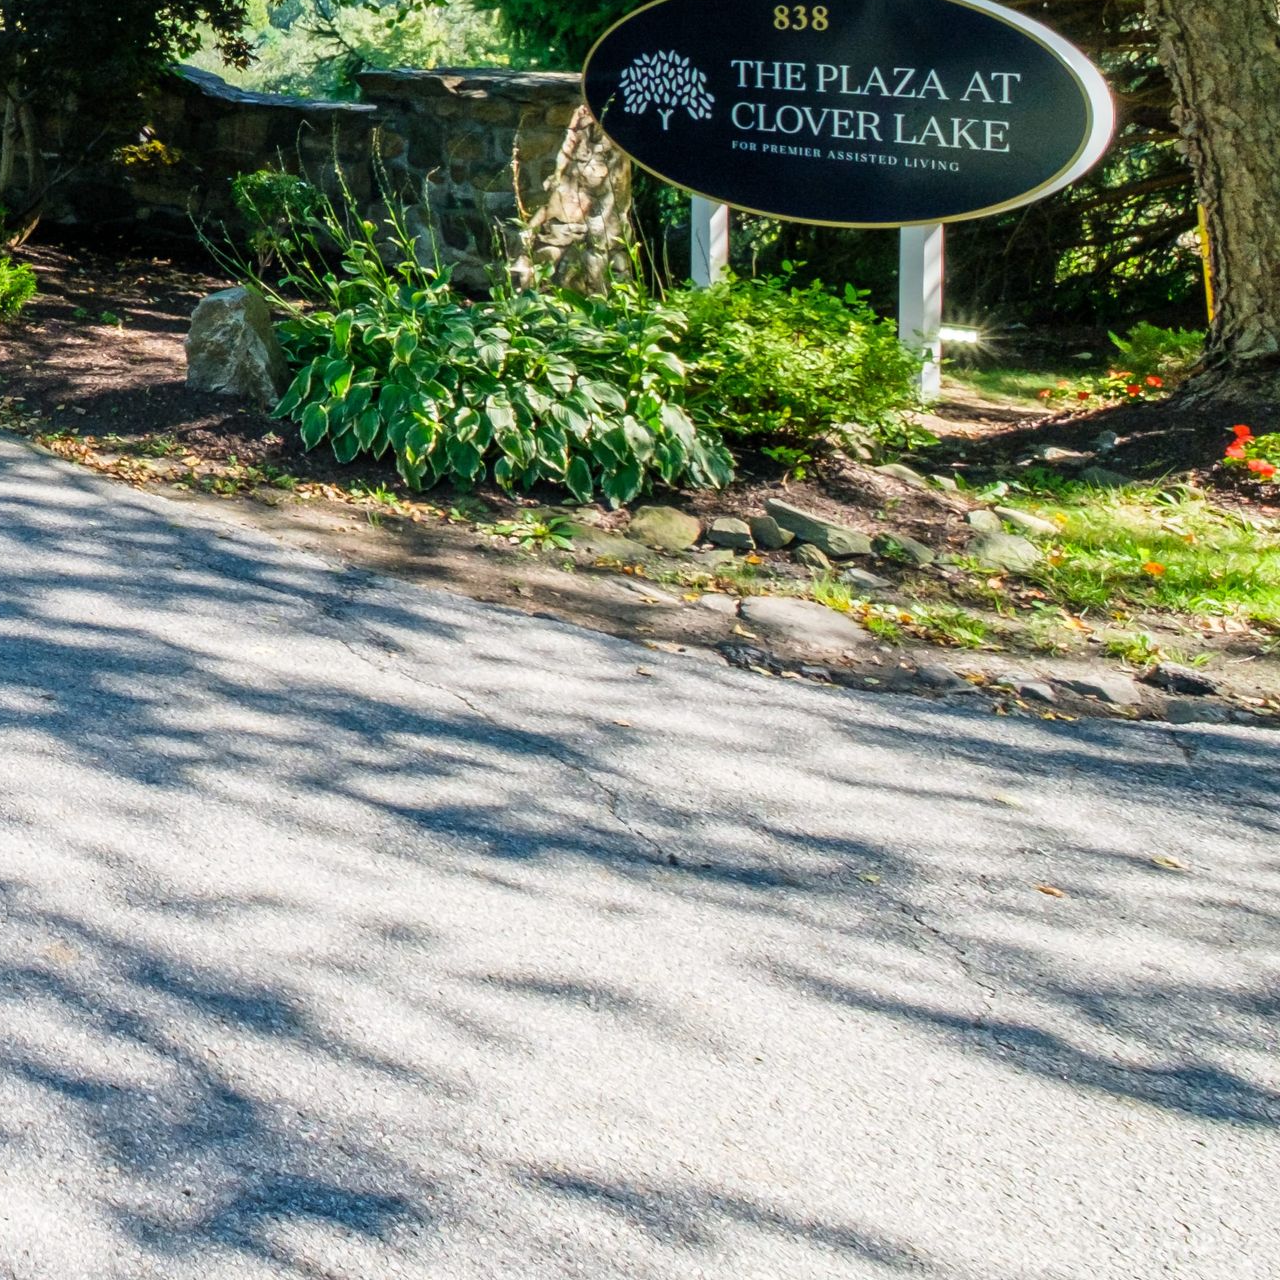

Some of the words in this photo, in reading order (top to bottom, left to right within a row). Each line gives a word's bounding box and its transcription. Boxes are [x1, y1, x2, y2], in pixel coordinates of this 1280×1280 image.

[773, 4, 829, 31] 838
[730, 59, 806, 92] THE
[815, 63, 950, 100] PLAZA
[959, 70, 1021, 105] AT
[731, 101, 883, 142] CLOVER
[893, 113, 1010, 153] LAKE
[731, 139, 757, 152] FOR
[761, 143, 822, 158] PREMIER
[827, 149, 898, 166] ASSISTED
[904, 156, 960, 172] LIVING
